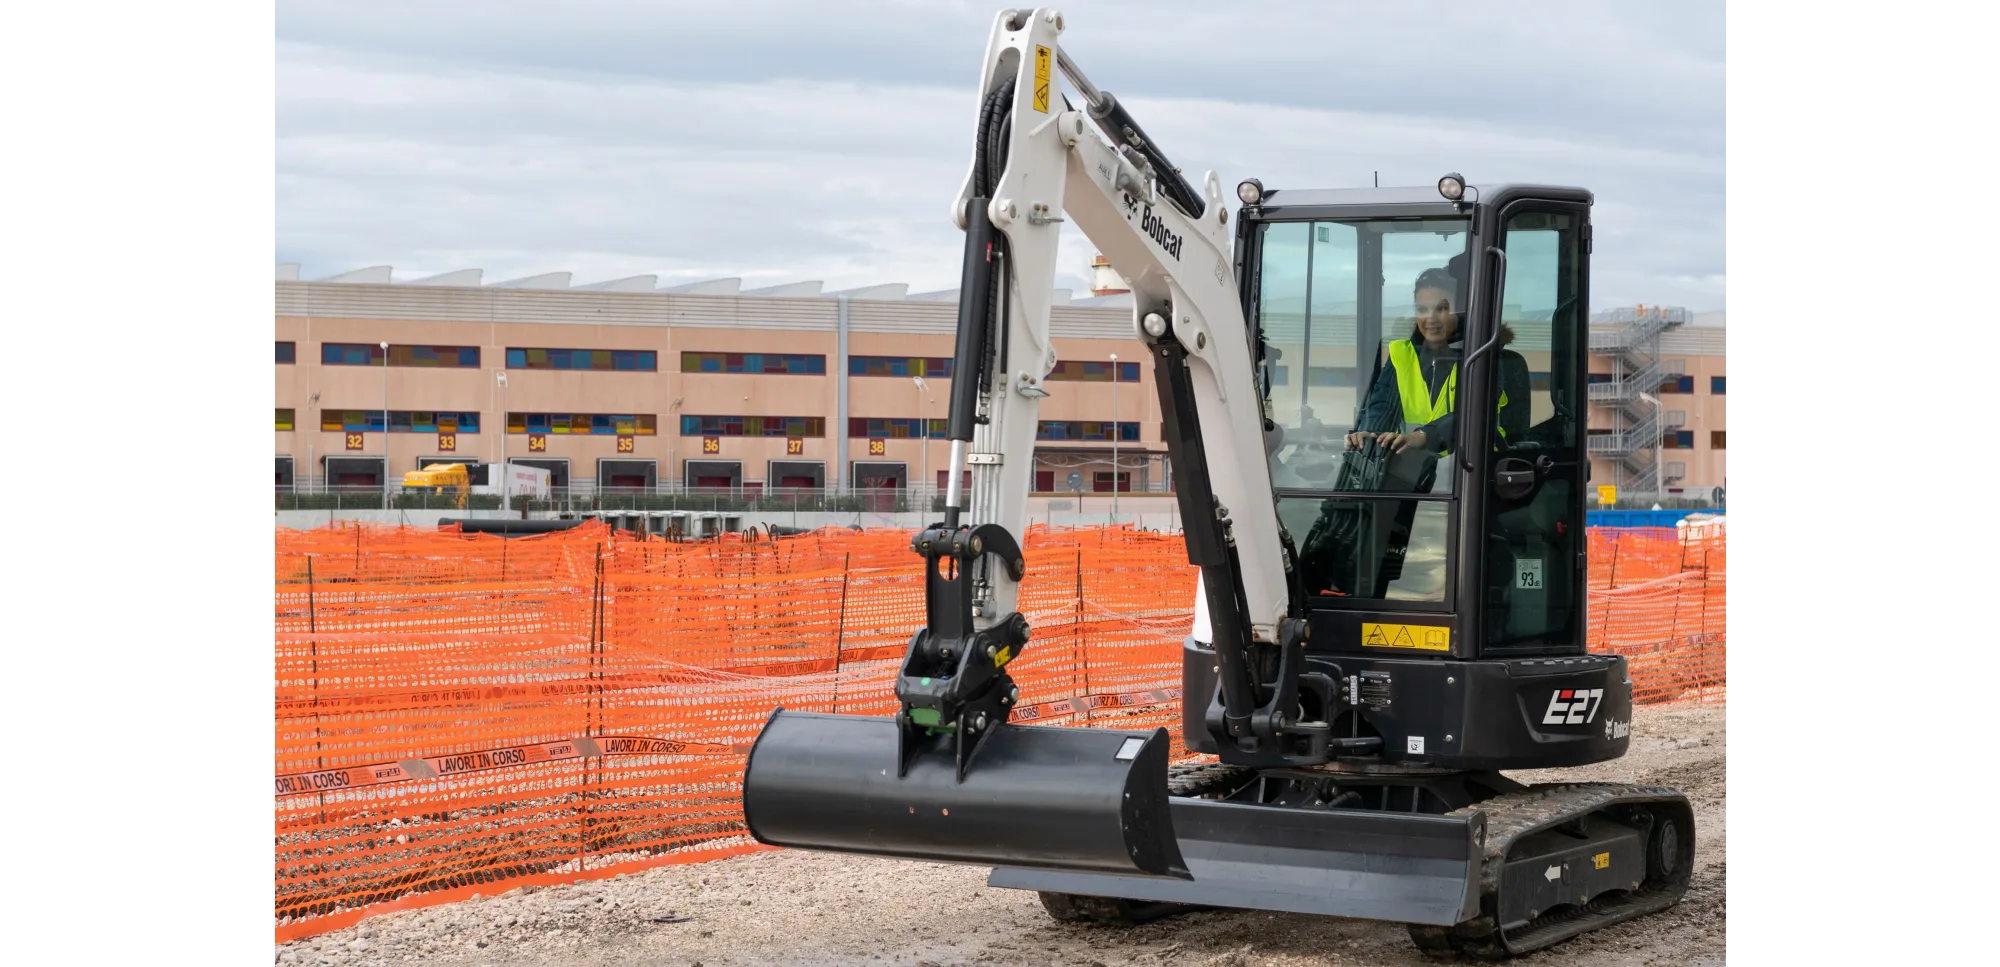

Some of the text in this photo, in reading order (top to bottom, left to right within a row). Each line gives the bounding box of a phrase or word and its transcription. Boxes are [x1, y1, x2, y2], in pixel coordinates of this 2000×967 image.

[1141, 204, 1183, 262] Bobcat
[347, 435, 362, 447] 32
[440, 436, 455, 448] 33
[530, 437, 544, 450] 34
[618, 438, 633, 450] 35
[704, 440, 718, 452] 36
[788, 440, 802, 452] 37
[870, 441, 884, 453] 38
[1521, 572, 1534, 586] 93
[1110, 695, 1119, 706] IN
[1542, 688, 1604, 724] E27
[605, 739, 687, 753] LAVORI IN CORSO
[438, 752, 477, 774] LAVORI
[479, 751, 492, 767] IN
[493, 748, 526, 766] CORSO
[299, 775, 312, 791] IN
[313, 770, 350, 789] CORSO
